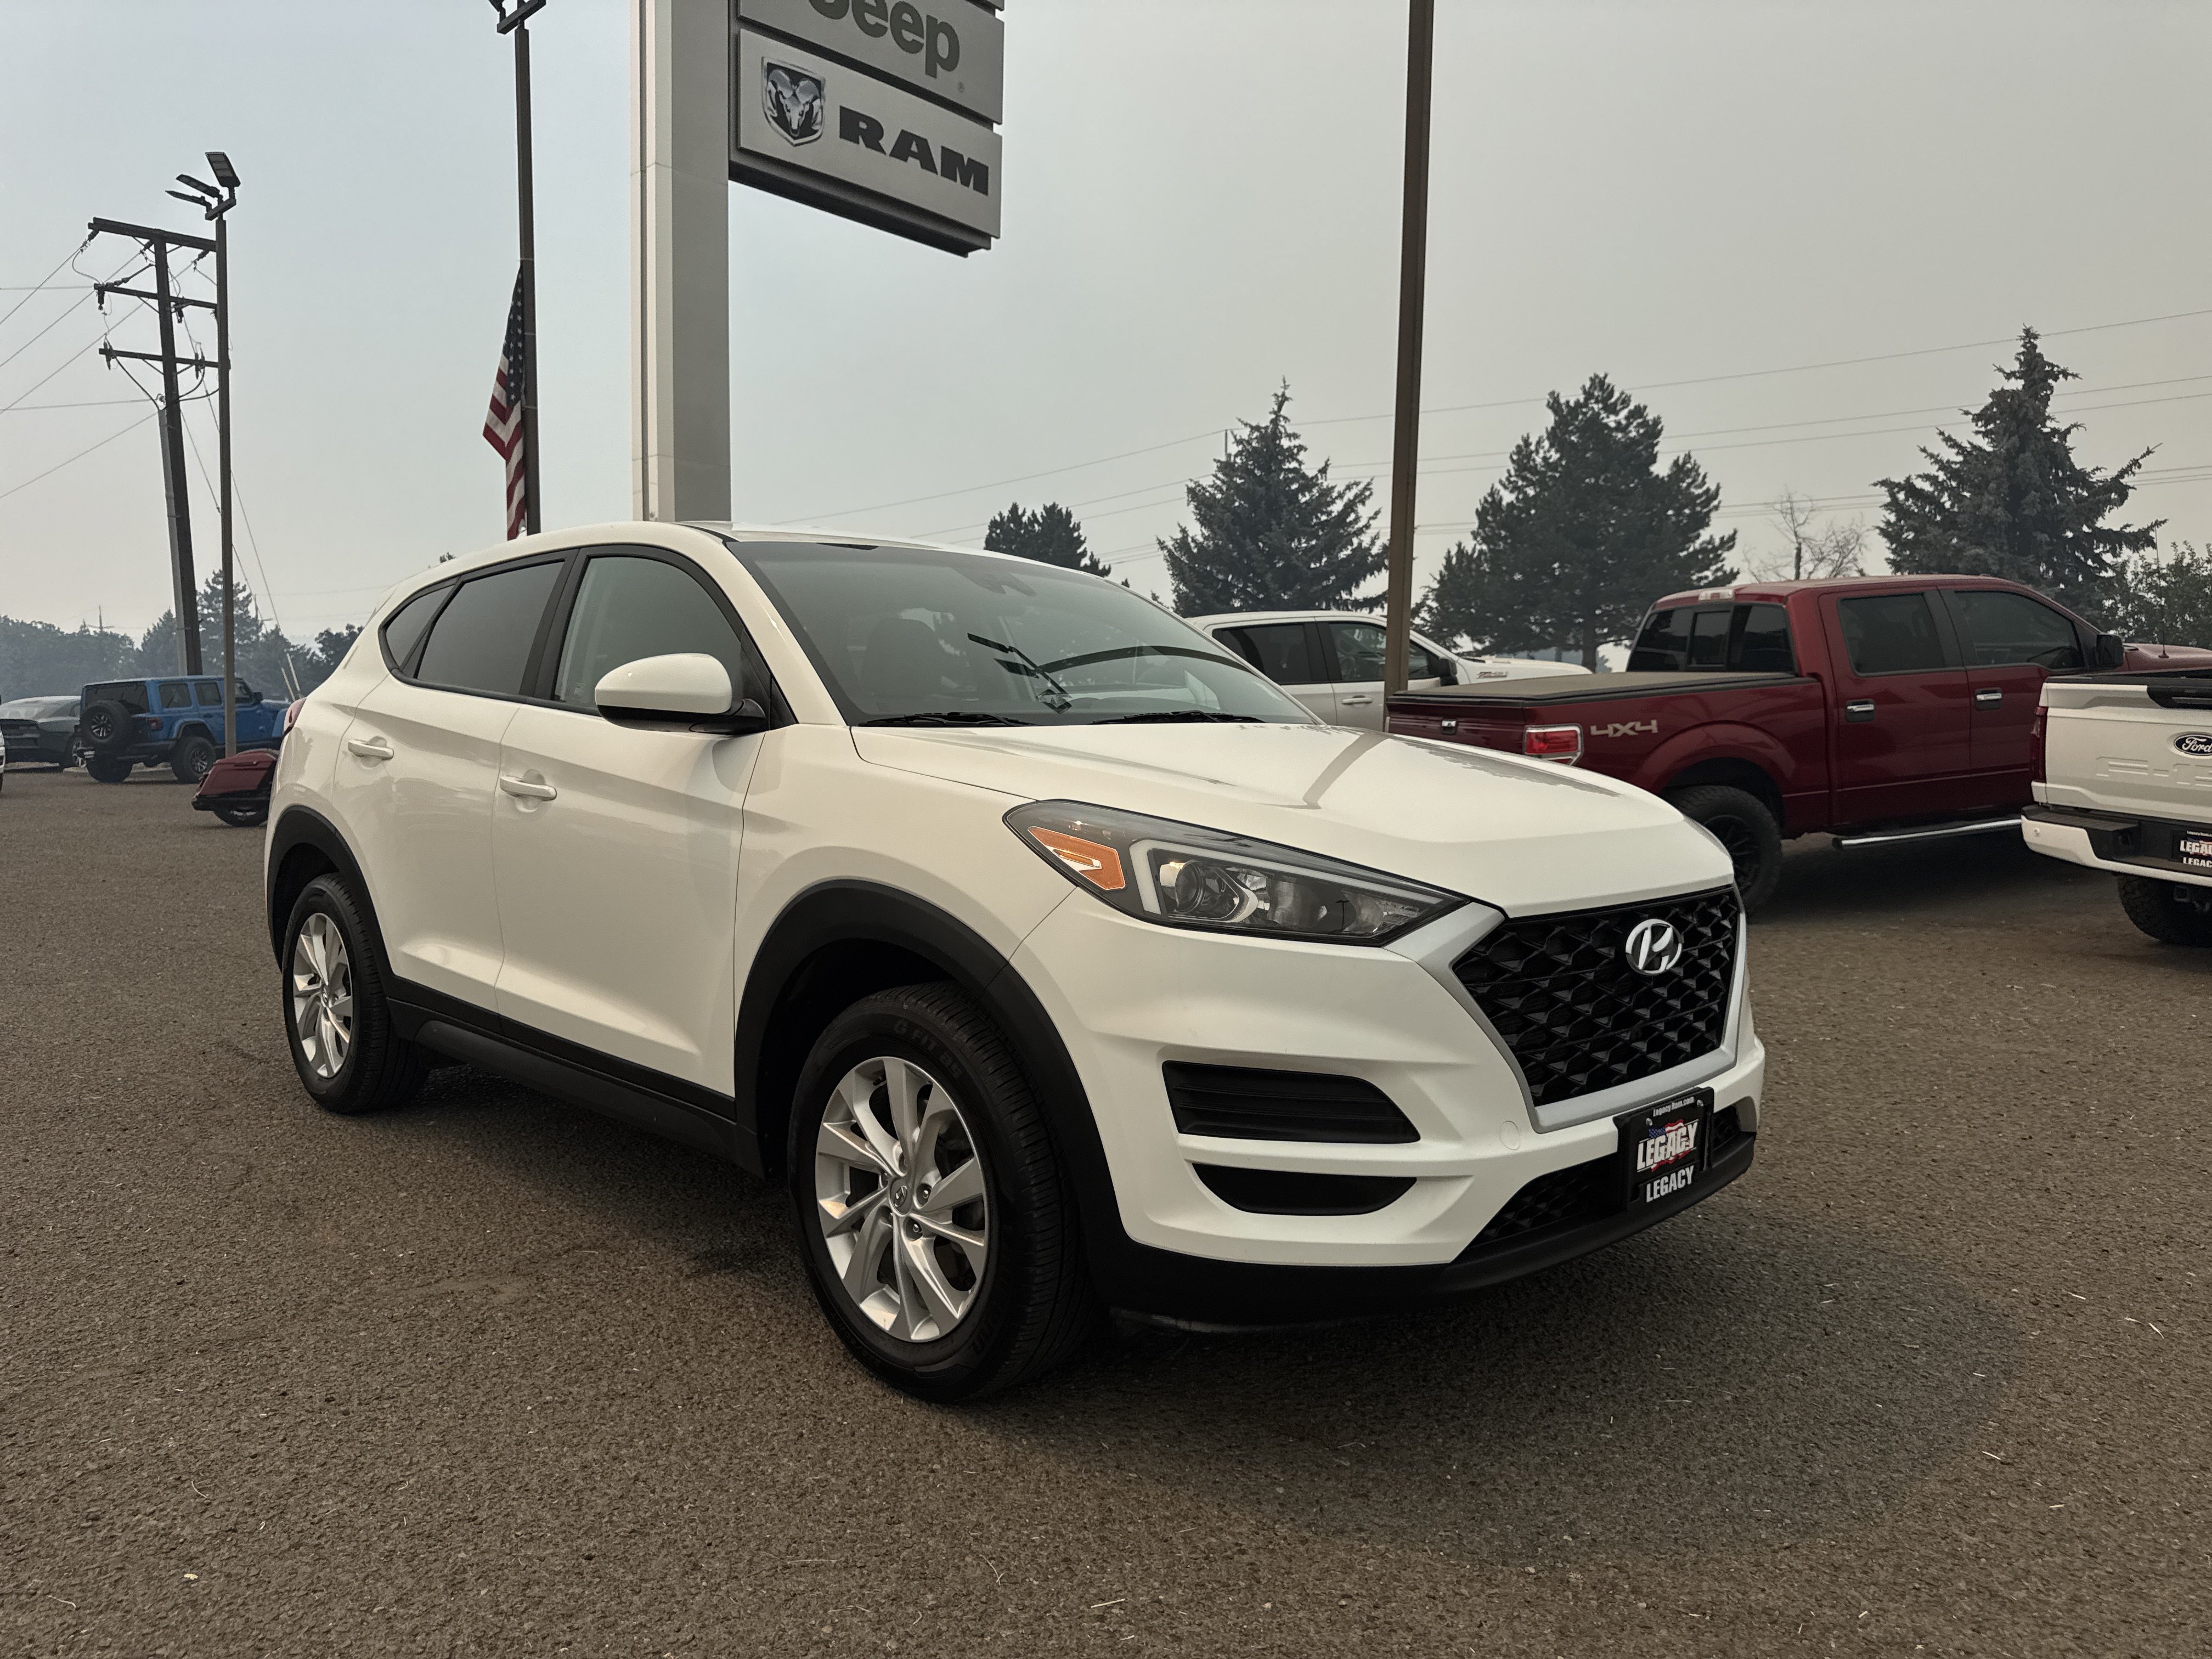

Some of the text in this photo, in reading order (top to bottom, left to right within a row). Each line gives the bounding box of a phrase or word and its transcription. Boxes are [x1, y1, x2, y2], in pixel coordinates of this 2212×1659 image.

[839, 105, 989, 196] RAM
[2182, 737, 2212, 752] Ford
[1637, 1122, 1698, 1170] LEGACY
[1646, 1165, 1694, 1203] LEGACY
